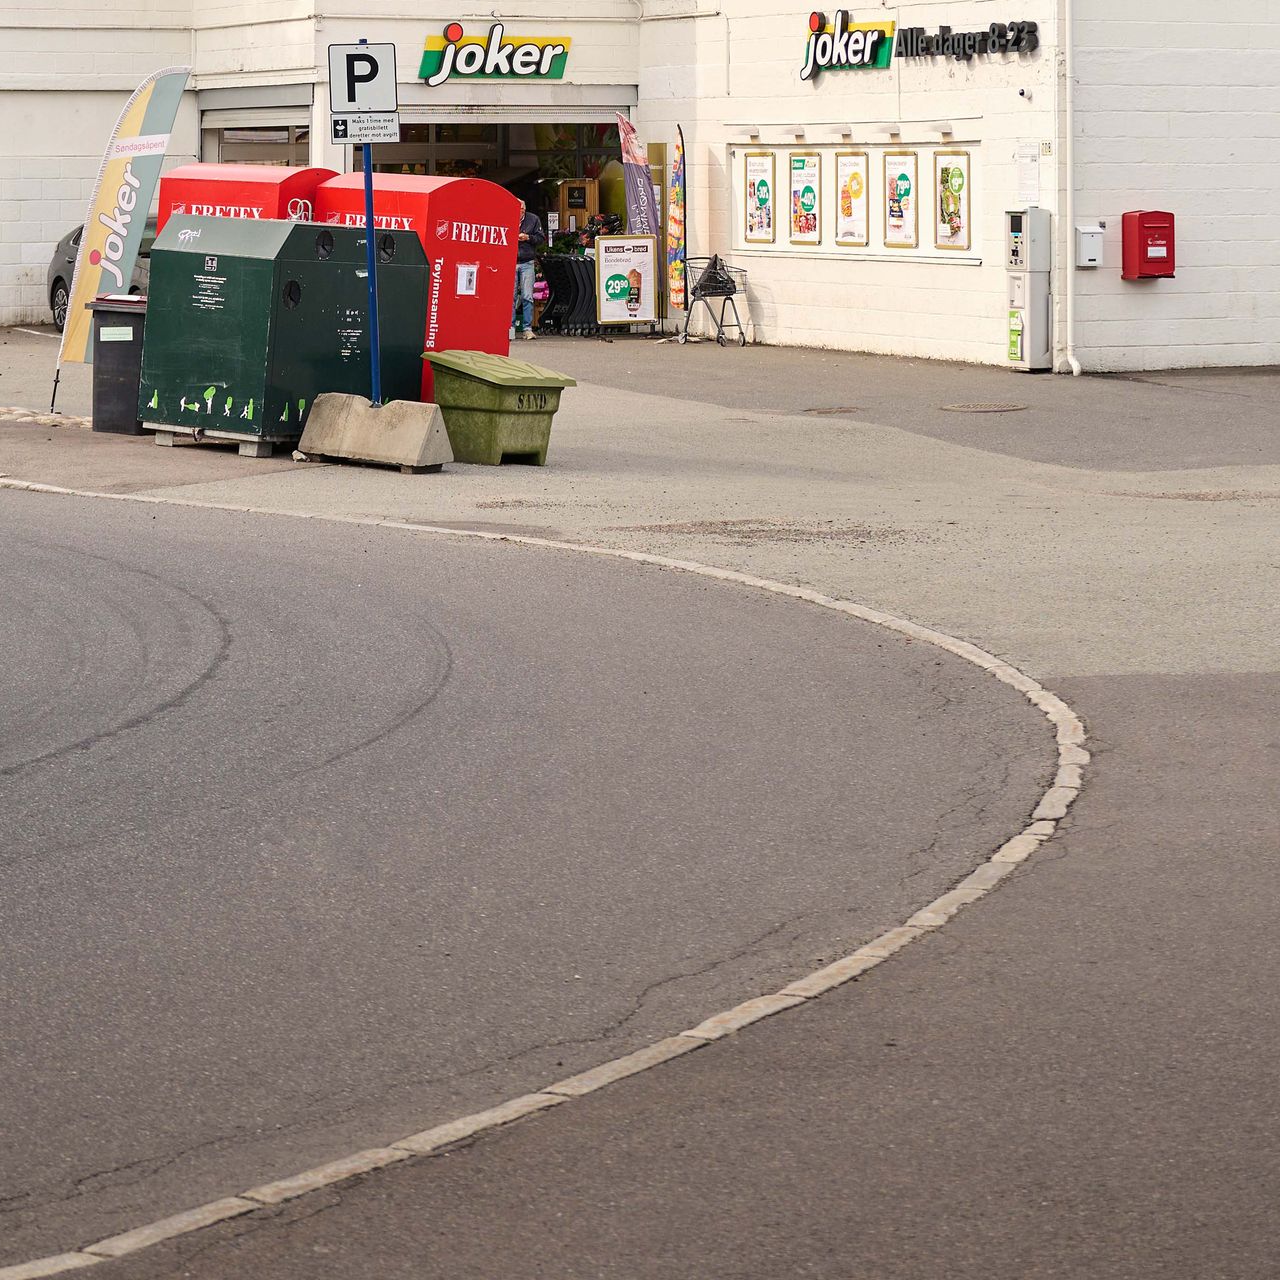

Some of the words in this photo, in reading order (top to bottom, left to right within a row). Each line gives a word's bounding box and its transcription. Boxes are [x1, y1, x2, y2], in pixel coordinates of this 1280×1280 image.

[424, 22, 566, 87] joker
[800, 9, 882, 80] joker
[895, 27, 927, 57] Alle
[933, 27, 982, 61] dager
[987, 21, 1036, 55] 8-23
[346, 53, 379, 103] P
[115, 138, 166, 154] Søndagsåpent
[89, 161, 142, 289] joker
[190, 204, 264, 219] FRETEX
[451, 221, 509, 246] FRETEX
[425, 256, 444, 349] Tøyinnsamling
[517, 393, 547, 410] SAND
